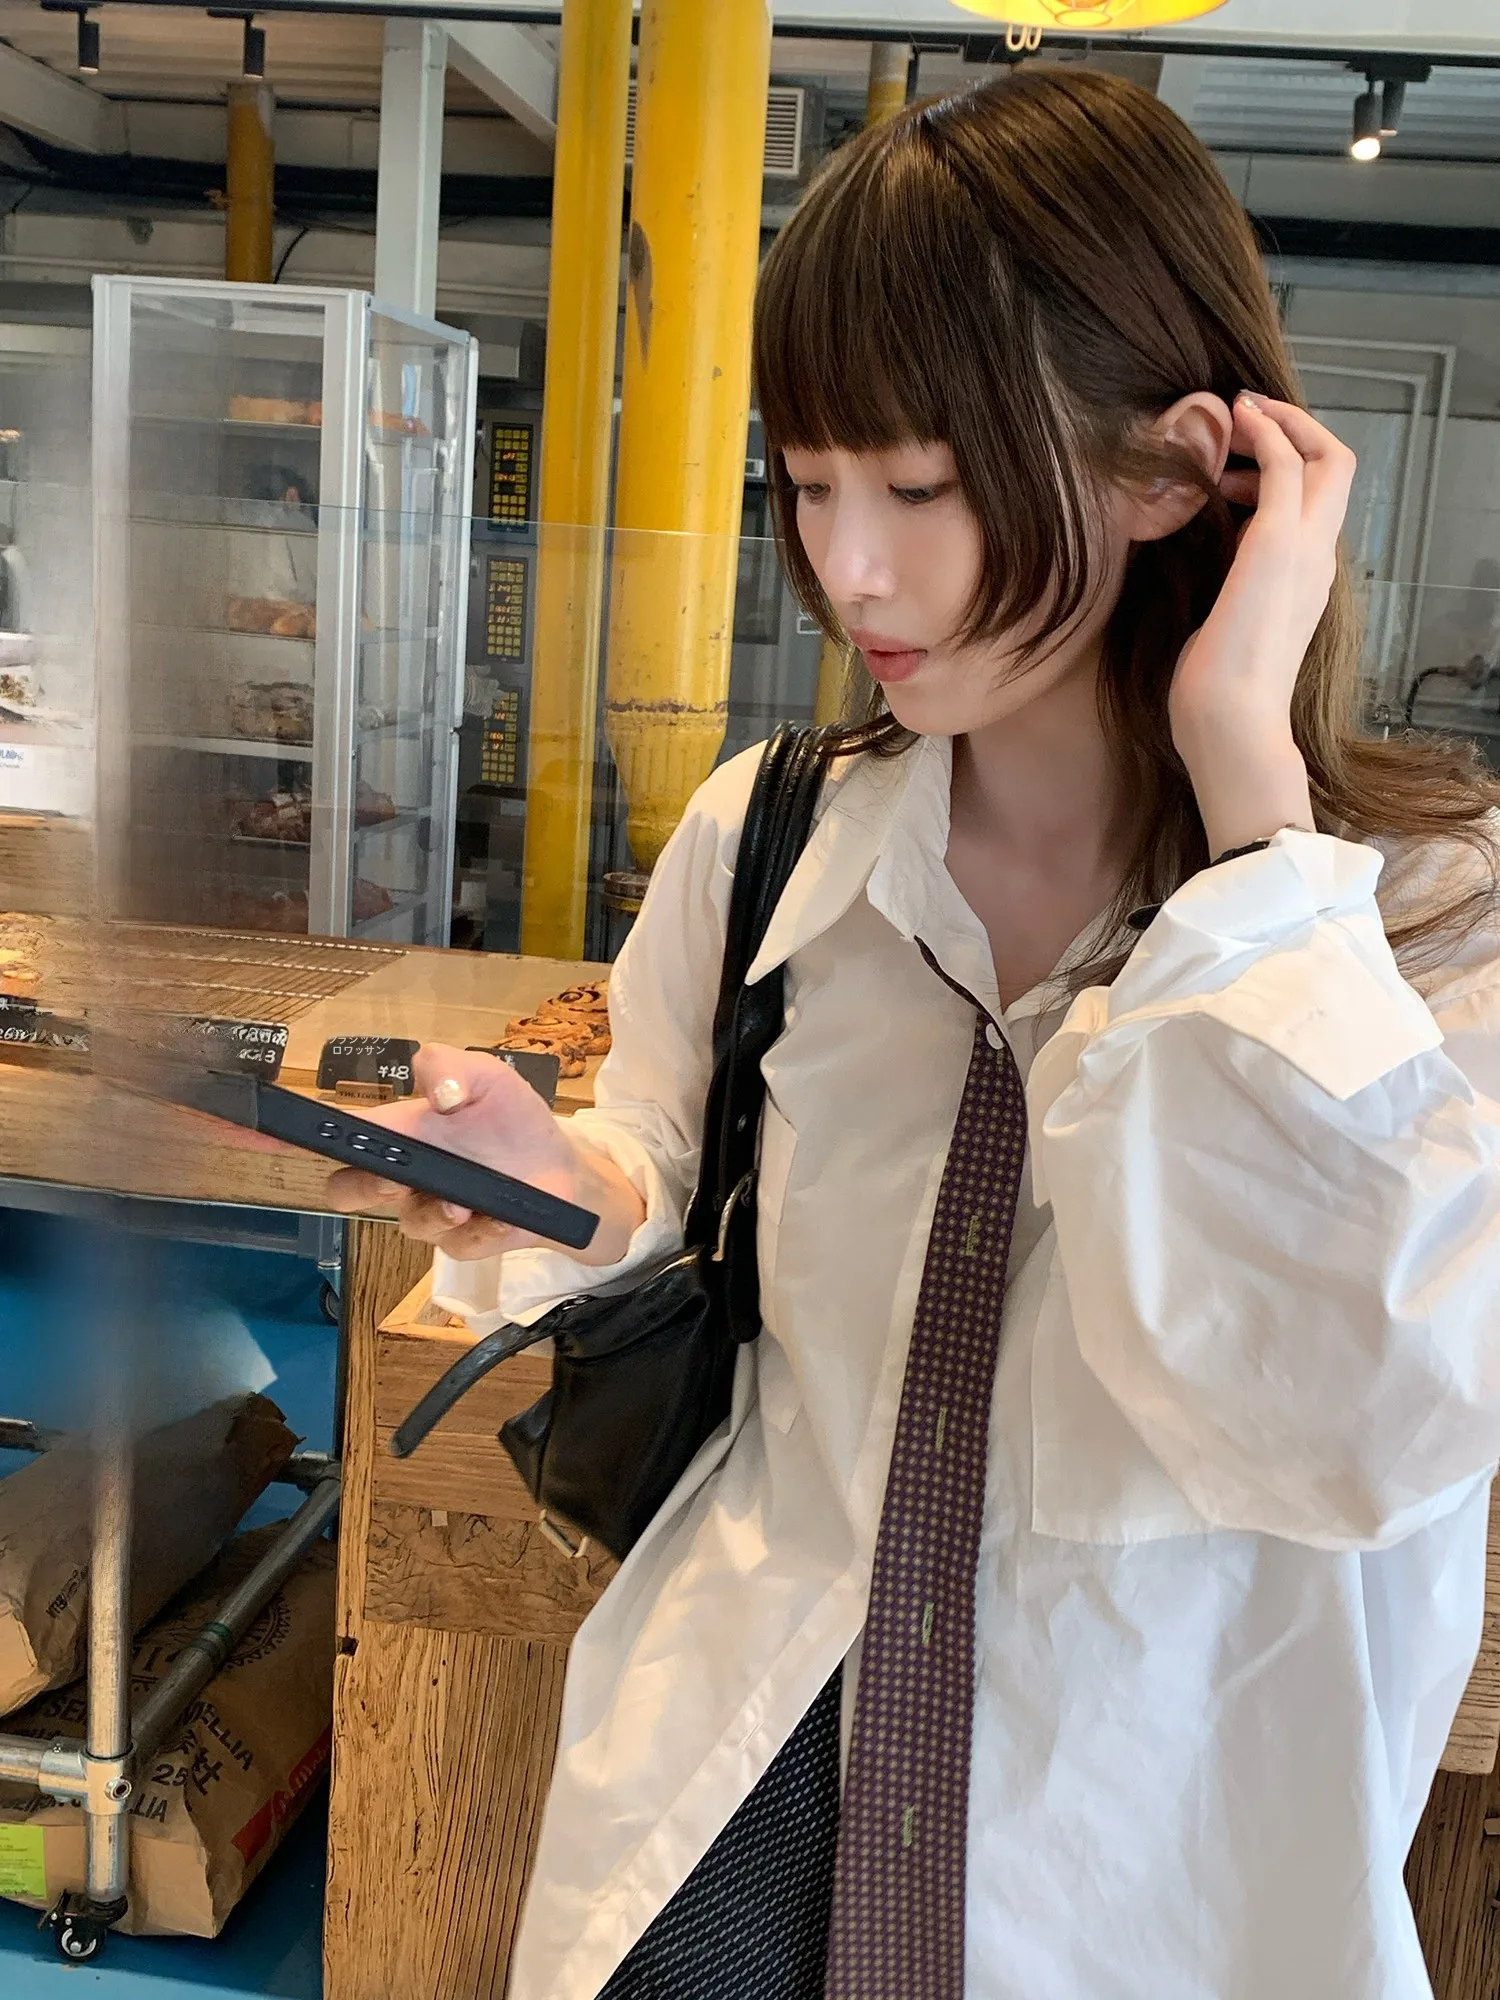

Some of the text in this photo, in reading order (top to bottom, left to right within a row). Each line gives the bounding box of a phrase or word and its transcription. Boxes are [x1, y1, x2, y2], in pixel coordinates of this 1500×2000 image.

[333, 1046, 386, 1056] ロワッサン
[378, 1065, 410, 1080] ¥18
